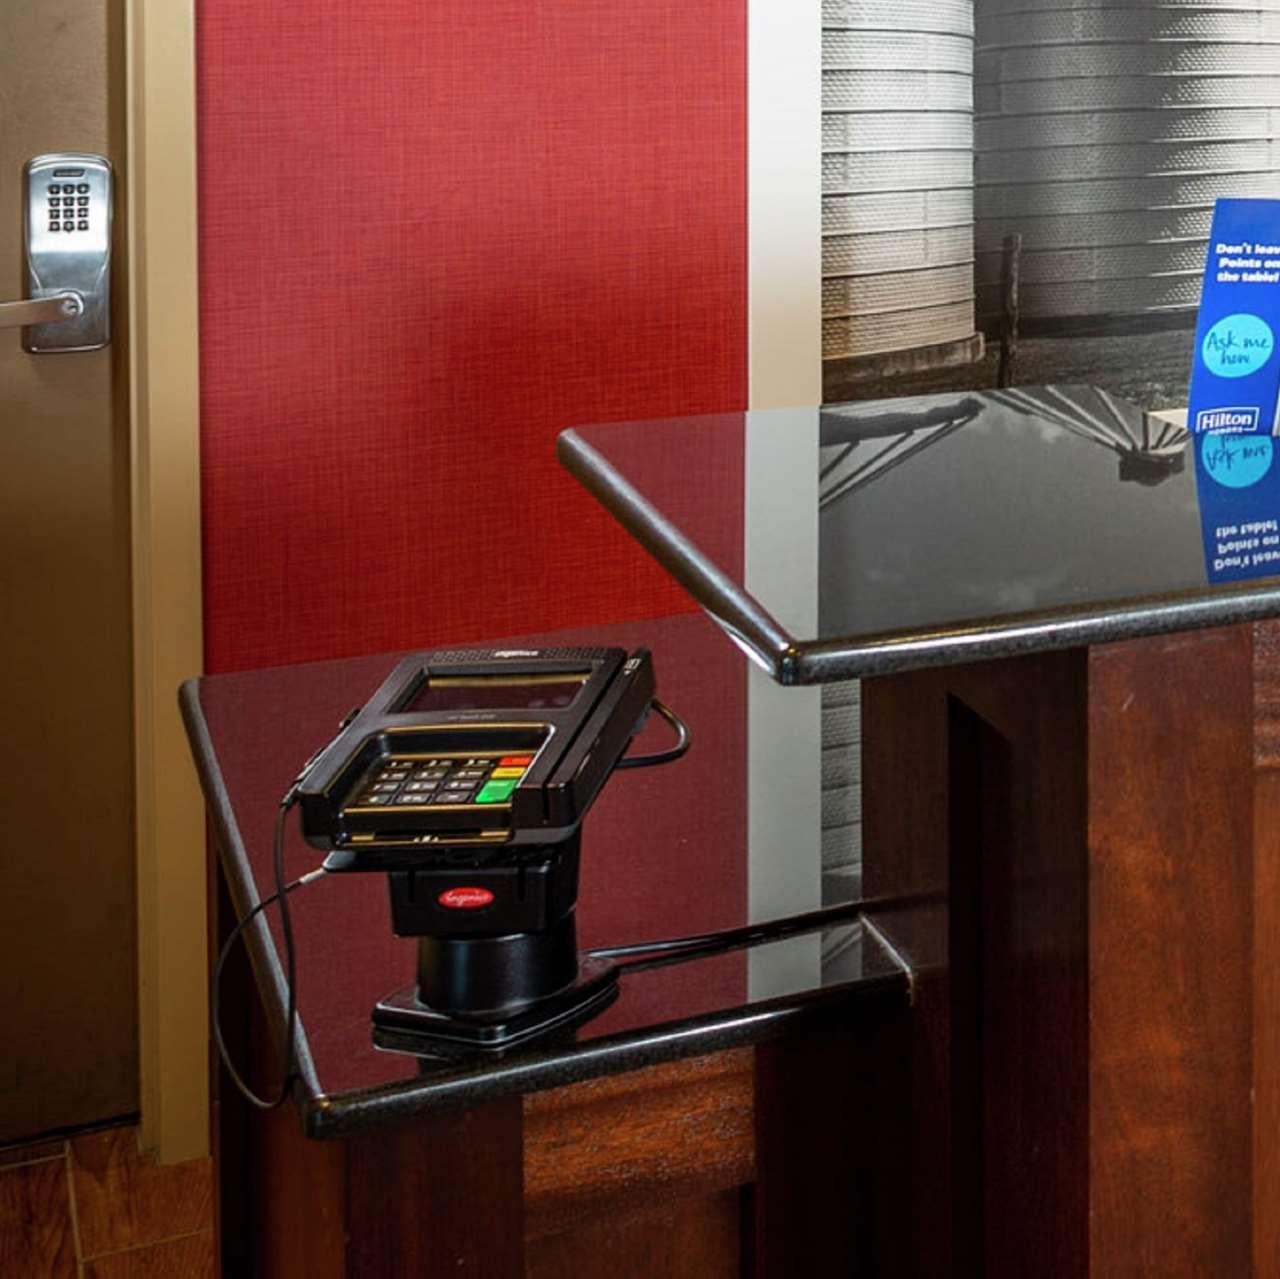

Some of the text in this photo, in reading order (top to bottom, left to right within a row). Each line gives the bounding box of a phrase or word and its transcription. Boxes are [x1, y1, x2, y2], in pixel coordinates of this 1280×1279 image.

[1216, 242, 1252, 255] Don't
[1218, 257, 1262, 268] Points
[1217, 271, 1240, 282] the
[1207, 330, 1271, 352] Ask me
[1201, 412, 1253, 431] Hilton
